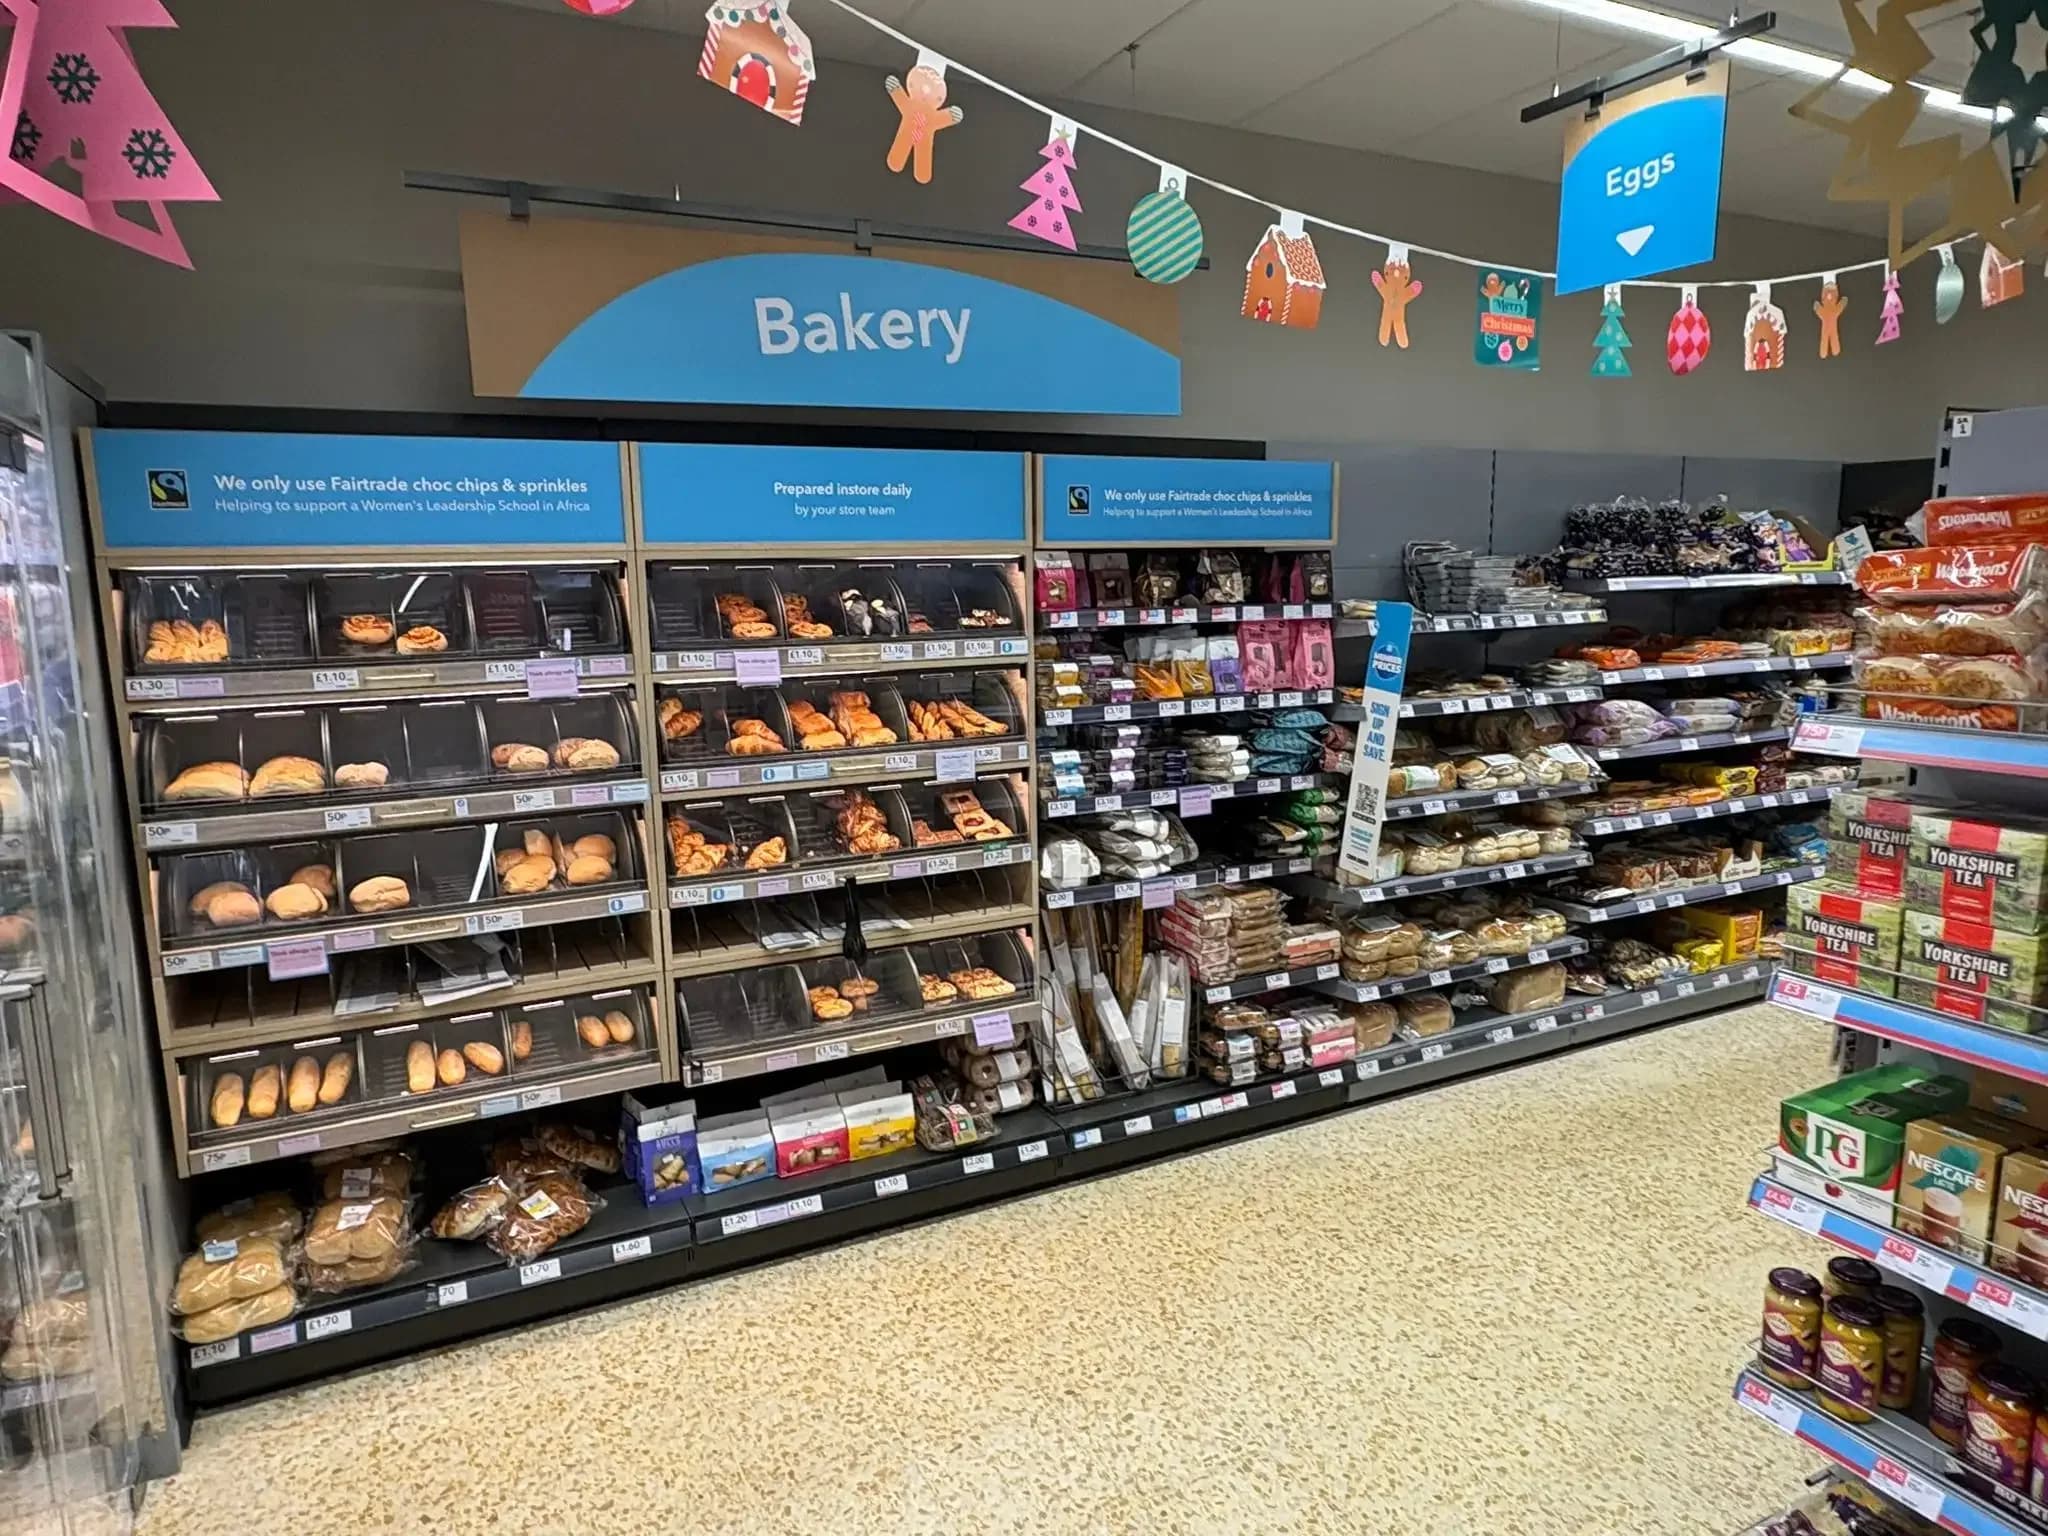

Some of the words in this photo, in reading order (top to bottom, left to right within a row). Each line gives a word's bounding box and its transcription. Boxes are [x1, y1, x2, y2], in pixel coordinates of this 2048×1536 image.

[1606, 152, 1676, 197] Eggs
[754, 292, 971, 364] Bakery
[213, 474, 248, 491] We
[251, 475, 290, 495] only
[296, 479, 326, 491] use
[331, 476, 408, 492] Fairtrade
[413, 478, 450, 492] choc
[456, 478, 498, 496] chips
[502, 478, 515, 492] &
[519, 478, 588, 496] sprinkles
[774, 482, 834, 498] Prepared
[837, 483, 880, 496] instore
[883, 483, 912, 499] daily
[1104, 490, 1122, 501] We
[1124, 490, 1146, 503] only
[1149, 492, 1166, 501] use
[1168, 491, 1211, 501] Fairtrade
[1213, 491, 1236, 501] choc
[1237, 491, 1261, 504] chips
[1263, 491, 1271, 501] &
[1272, 491, 1312, 504] sprinkles
[215, 499, 272, 514] Helping
[276, 501, 290, 512] to
[295, 502, 348, 515] support
[351, 503, 358, 512] a
[361, 500, 423, 512] Women's
[427, 500, 496, 515] Leadership
[499, 500, 540, 512] School
[543, 501, 554, 512] in
[556, 501, 590, 512] Africa
[794, 503, 808, 518] by
[811, 505, 836, 518] your
[839, 504, 866, 515] store
[868, 504, 896, 515] team
[1104, 507, 1134, 518] Helping
[1146, 508, 1176, 518] support
[1184, 507, 1217, 516] Women's
[1260, 507, 1284, 516] School
[883, 645, 904, 653] £1.10
[926, 642, 947, 651] £1.10
[966, 642, 986, 651] £1.10
[681, 654, 704, 663] £1.10
[790, 650, 813, 659] £1.10
[488, 664, 515, 673] £1.10
[1372, 660, 1402, 674] PRICES
[316, 672, 346, 682] £1.10
[129, 681, 163, 691] £1.30
[1370, 702, 1391, 717] SIGN
[1372, 717, 1384, 729] UP
[1367, 731, 1385, 746] AND
[887, 756, 909, 765] £1.10
[663, 775, 688, 785] £1.10
[1870, 842, 1895, 857] TEA
[1929, 847, 2016, 878] YORKSHIRE
[805, 874, 826, 885] £1.10
[1955, 869, 1984, 888] TEA
[674, 890, 698, 900] £1.10
[1804, 915, 1875, 946] YORKSHIRE
[1825, 937, 1849, 954] TEA
[1923, 943, 2009, 977] YORKSHIRE
[1949, 966, 1977, 985] TEA
[1784, 982, 1801, 996] £3
[1814, 1124, 1858, 1169] PG
[877, 1178, 898, 1190] £1.10
[790, 1199, 813, 1210] £1.10
[724, 1215, 747, 1227] £1.20
[615, 1241, 640, 1253] £1.60
[1884, 1238, 1913, 1259] £1.75
[522, 1263, 549, 1277] £1.70
[1976, 1280, 2009, 1303] £1.75
[308, 1315, 339, 1330] £1.70
